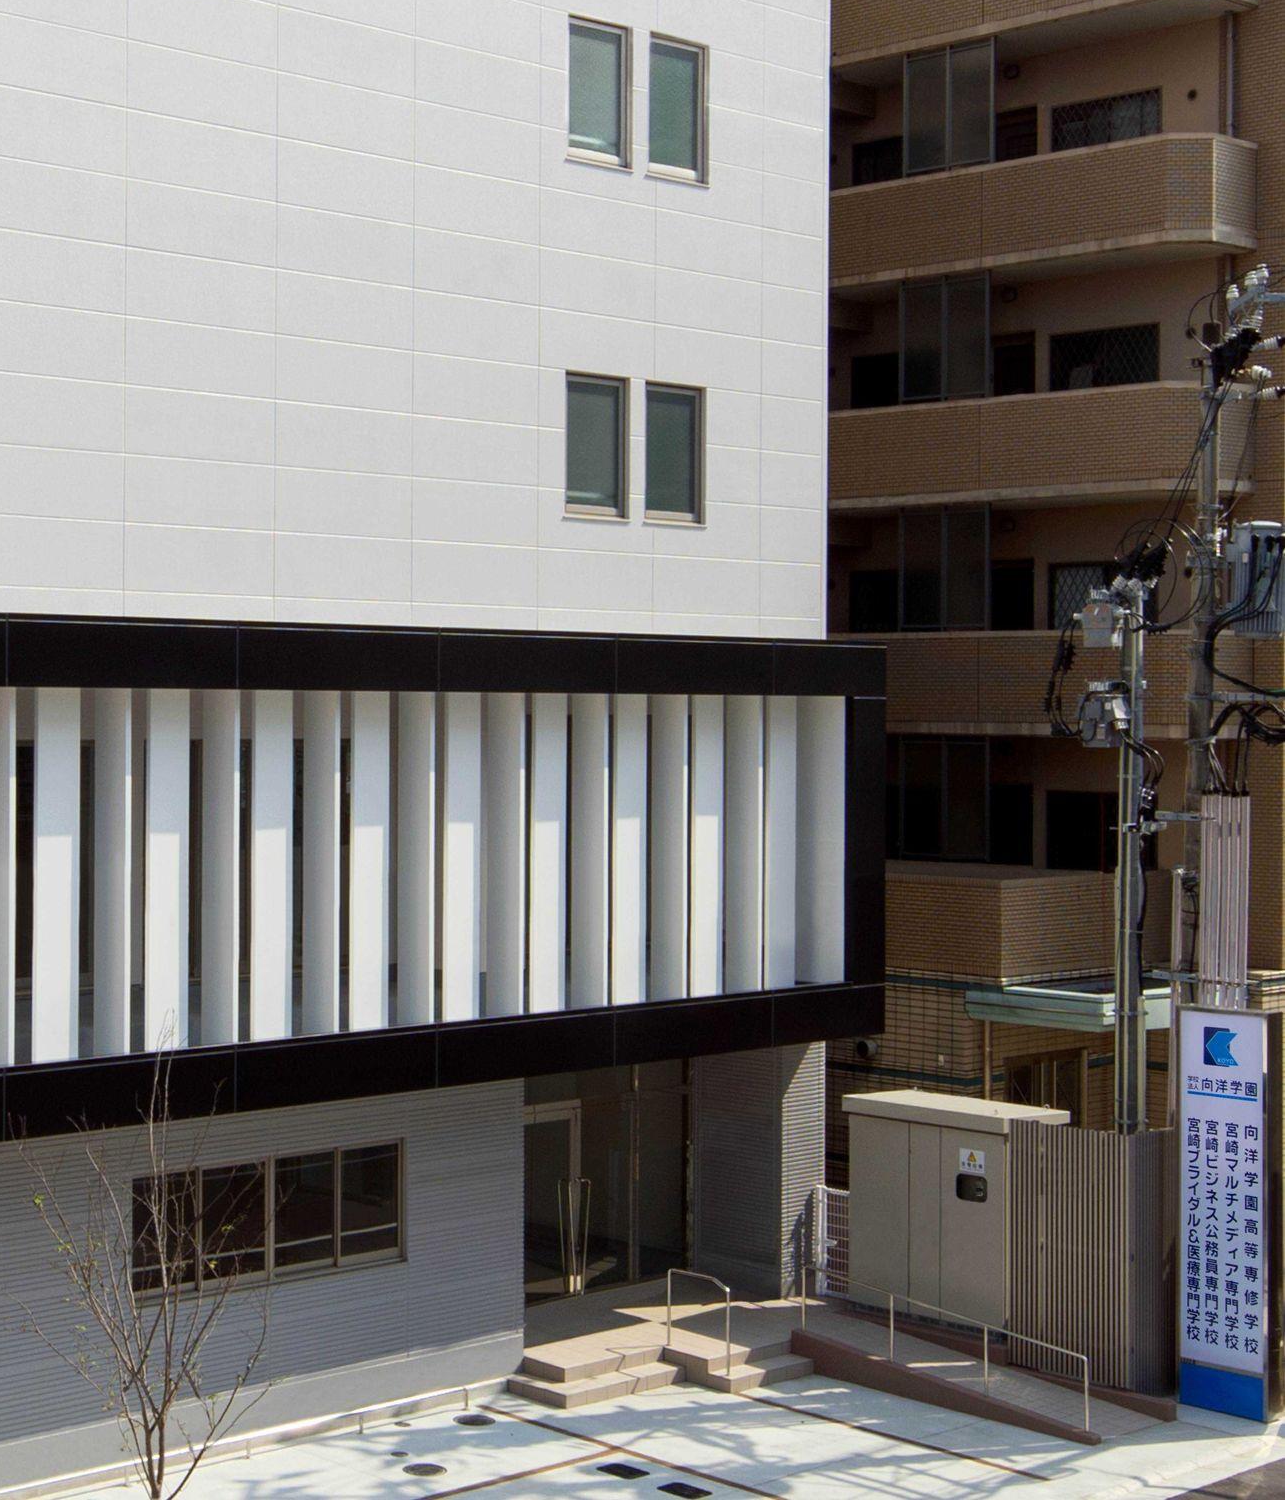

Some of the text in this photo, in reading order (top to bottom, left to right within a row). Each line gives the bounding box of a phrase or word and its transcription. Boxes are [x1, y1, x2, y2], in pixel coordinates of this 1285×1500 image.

[1202, 1077, 1258, 1097] 向洋学園
[1204, 1119, 1219, 1346] 宮崎ビジネス公務員専門学校
[1224, 1122, 1239, 1351] 宮崎マルチメディア専門学校
[1244, 1124, 1259, 1355] 向洋学園高等専修学校
